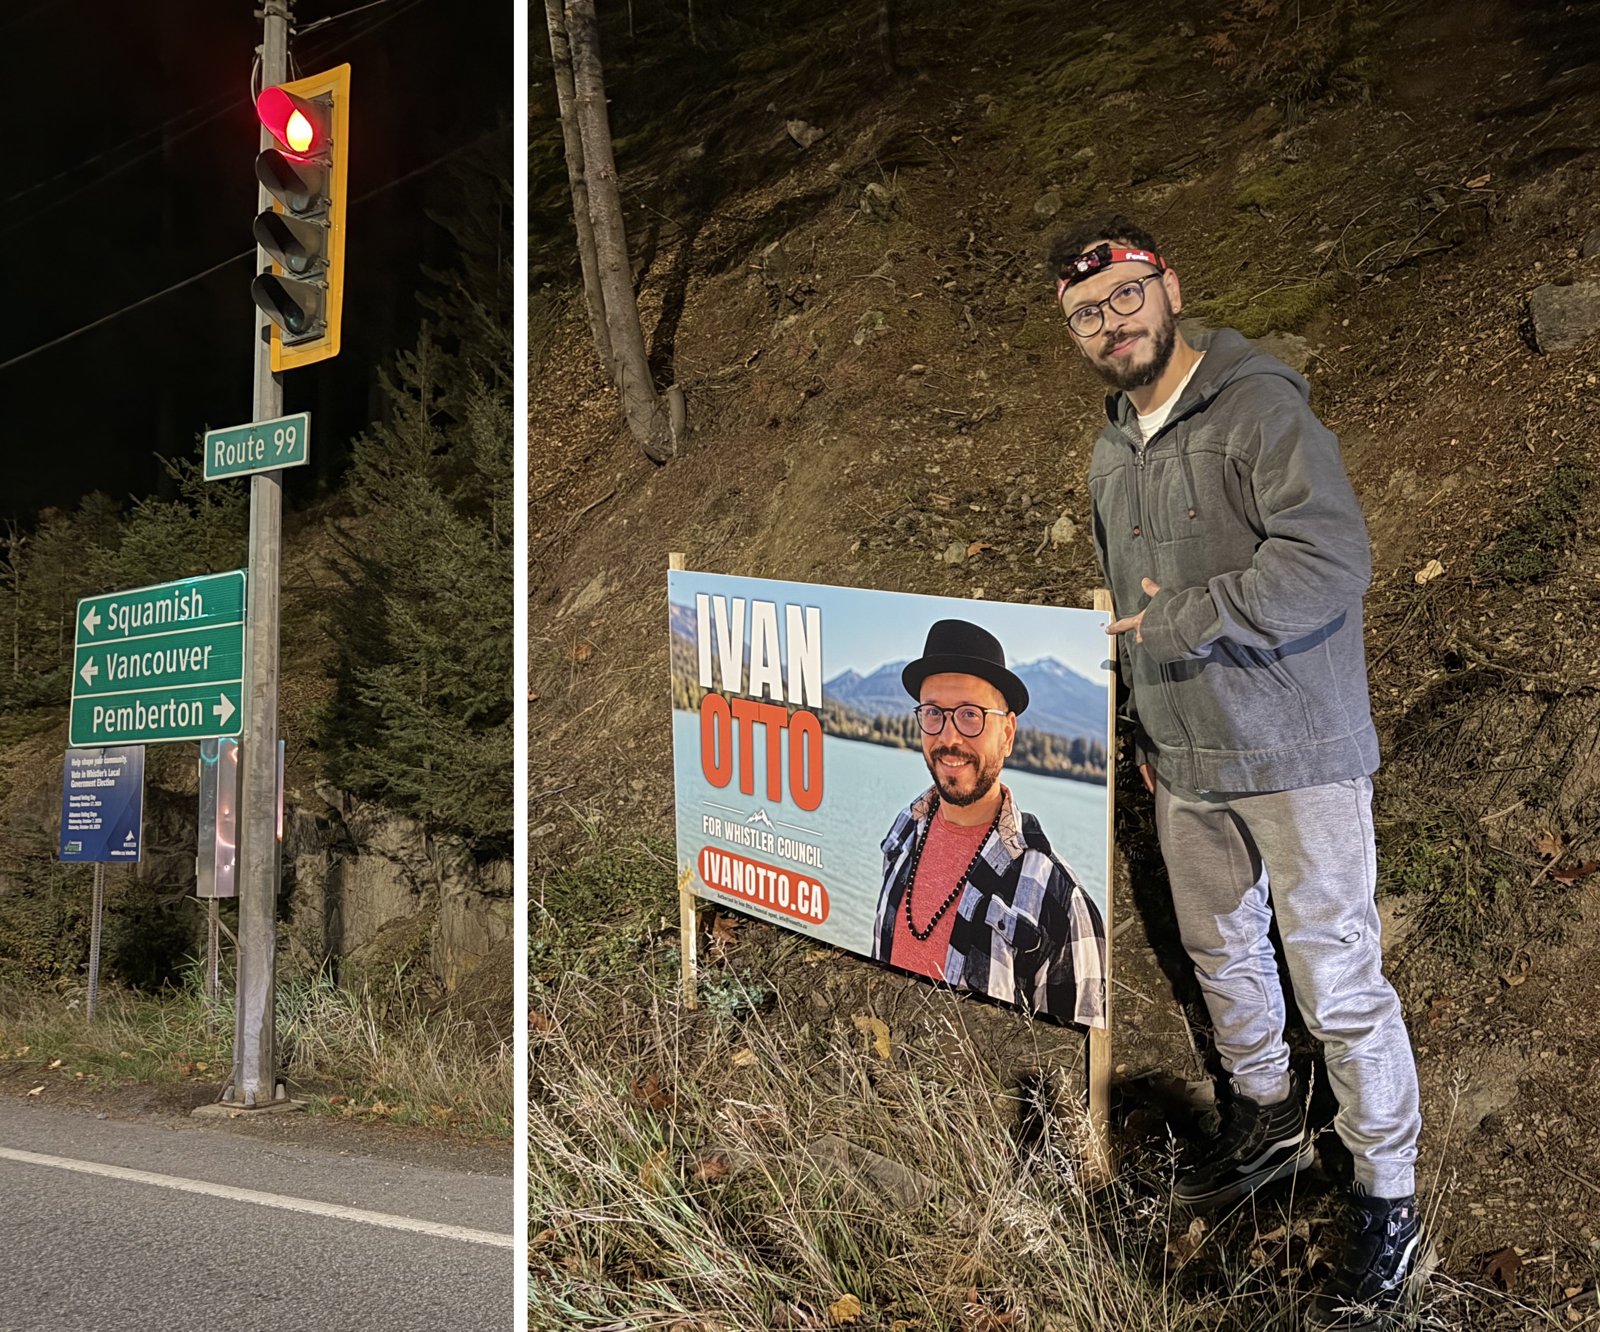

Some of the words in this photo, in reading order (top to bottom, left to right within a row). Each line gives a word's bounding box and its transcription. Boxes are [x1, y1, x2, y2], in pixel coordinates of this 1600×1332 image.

[214, 435, 265, 468] Route
[274, 425, 296, 456] 99
[107, 588, 203, 636] Squamish
[106, 645, 213, 681] Vancouver
[696, 593, 823, 709] IVAN
[93, 698, 203, 734] Pemberton
[108, 767, 121, 777] Local
[700, 692, 824, 812] OTTO
[702, 815, 722, 838] FOR
[724, 821, 775, 854] WHISTLER
[777, 836, 824, 869] COUNCIL
[703, 850, 823, 920] IVANOTTO.CA
